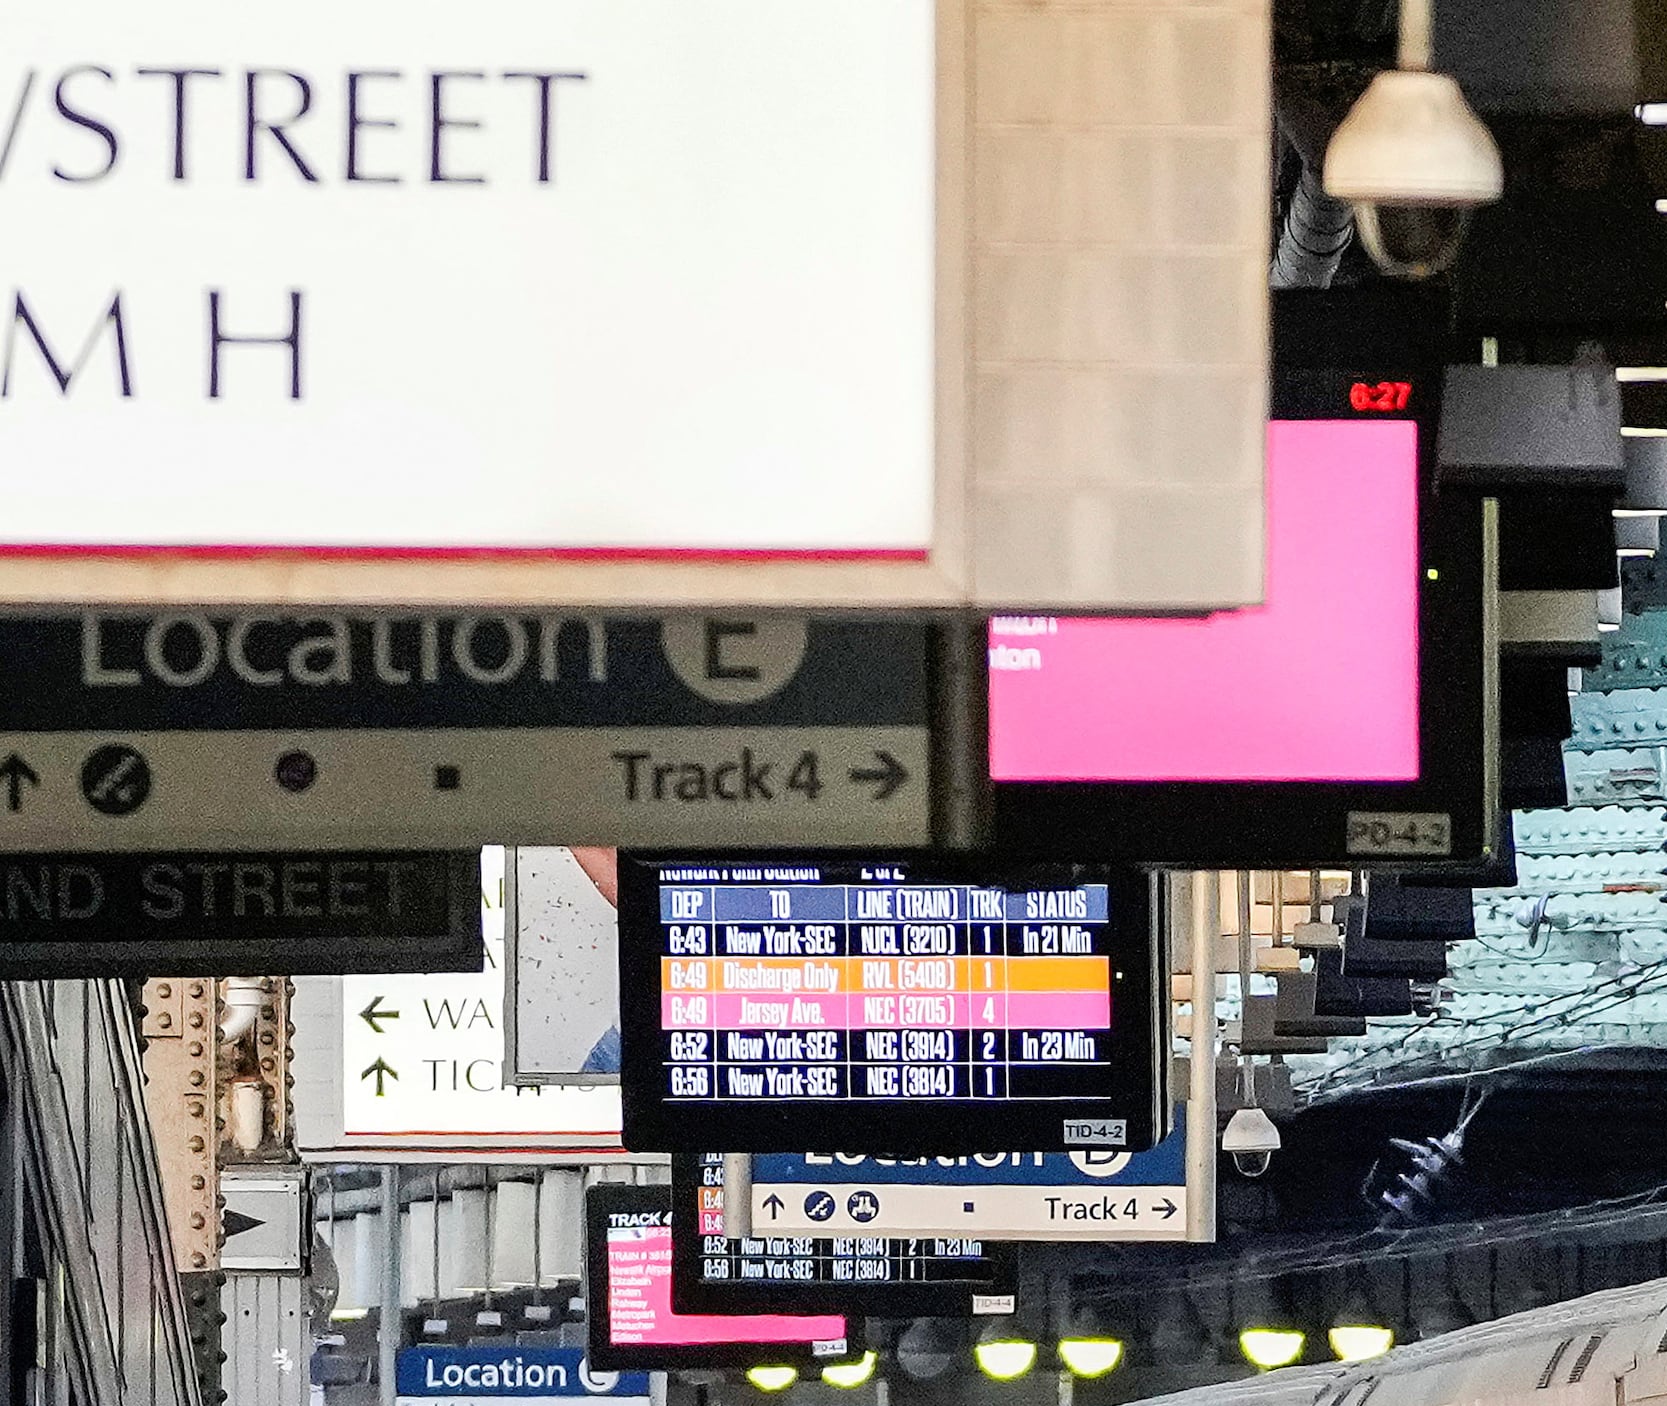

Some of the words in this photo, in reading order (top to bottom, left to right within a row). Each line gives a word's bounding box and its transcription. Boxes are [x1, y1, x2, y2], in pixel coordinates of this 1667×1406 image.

[209, 290, 302, 399] H
[1349, 381, 1413, 412] 6:27
[613, 750, 774, 802] Track
[787, 751, 823, 800] 4
[140, 863, 418, 920] STREET
[672, 891, 703, 918] DEP
[769, 891, 791, 918] TO
[857, 890, 893, 919] LINE
[896, 889, 958, 920] (TRAIN)
[970, 891, 1003, 918] TRK
[1027, 890, 1087, 918] STATUS
[669, 926, 707, 954] 6:43
[726, 926, 761, 954] New
[763, 926, 836, 954] York-SEC
[861, 926, 900, 953] NJCL
[903, 924, 955, 955] (3210)
[983, 926, 991, 953] 1
[1023, 926, 1039, 953] In
[1041, 926, 1059, 953] 21
[1061, 926, 1092, 953] Min
[670, 962, 707, 989] 6:49
[723, 962, 801, 992] Discharge
[804, 962, 838, 992] Only
[863, 961, 894, 988] RVL
[984, 961, 992, 988] 1
[671, 997, 707, 1024] 6:49
[738, 997, 789, 1028] Jersey
[791, 997, 825, 1025] Ave.
[864, 997, 895, 1024] NEC
[899, 995, 955, 1026] (3705)
[983, 997, 994, 1024] 4
[670, 1033, 708, 1060] 6:52
[728, 1032, 763, 1060] New
[765, 1032, 838, 1060] York-SEC
[866, 1032, 897, 1059] NEC
[901, 1030, 954, 1061] (3914)
[983, 1032, 995, 1059] 2
[1022, 1032, 1038, 1059] In
[1041, 1032, 1063, 1059] 23
[1065, 1032, 1095, 1059] Min
[671, 1068, 709, 1096] 6:56
[728, 1067, 764, 1095] New
[766, 1067, 838, 1096] York-SEC
[867, 1067, 898, 1095] NEC
[902, 1065, 954, 1097] (3814)
[986, 1067, 993, 1095] 1
[1065, 1124, 1123, 1139] TID-4-2
[609, 1211, 662, 1226] TRACK
[663, 1211, 673, 1226] 4
[1044, 1197, 1117, 1220] Track
[1124, 1198, 1140, 1220] 4
[741, 1237, 764, 1256] New
[833, 1237, 854, 1256] NEC
[909, 1238, 917, 1256] 2
[935, 1238, 945, 1256] In
[947, 1238, 960, 1256] 23
[741, 1260, 764, 1279] New
[833, 1260, 854, 1279] NEC
[910, 1260, 916, 1279] 1
[425, 1357, 568, 1388] Location
